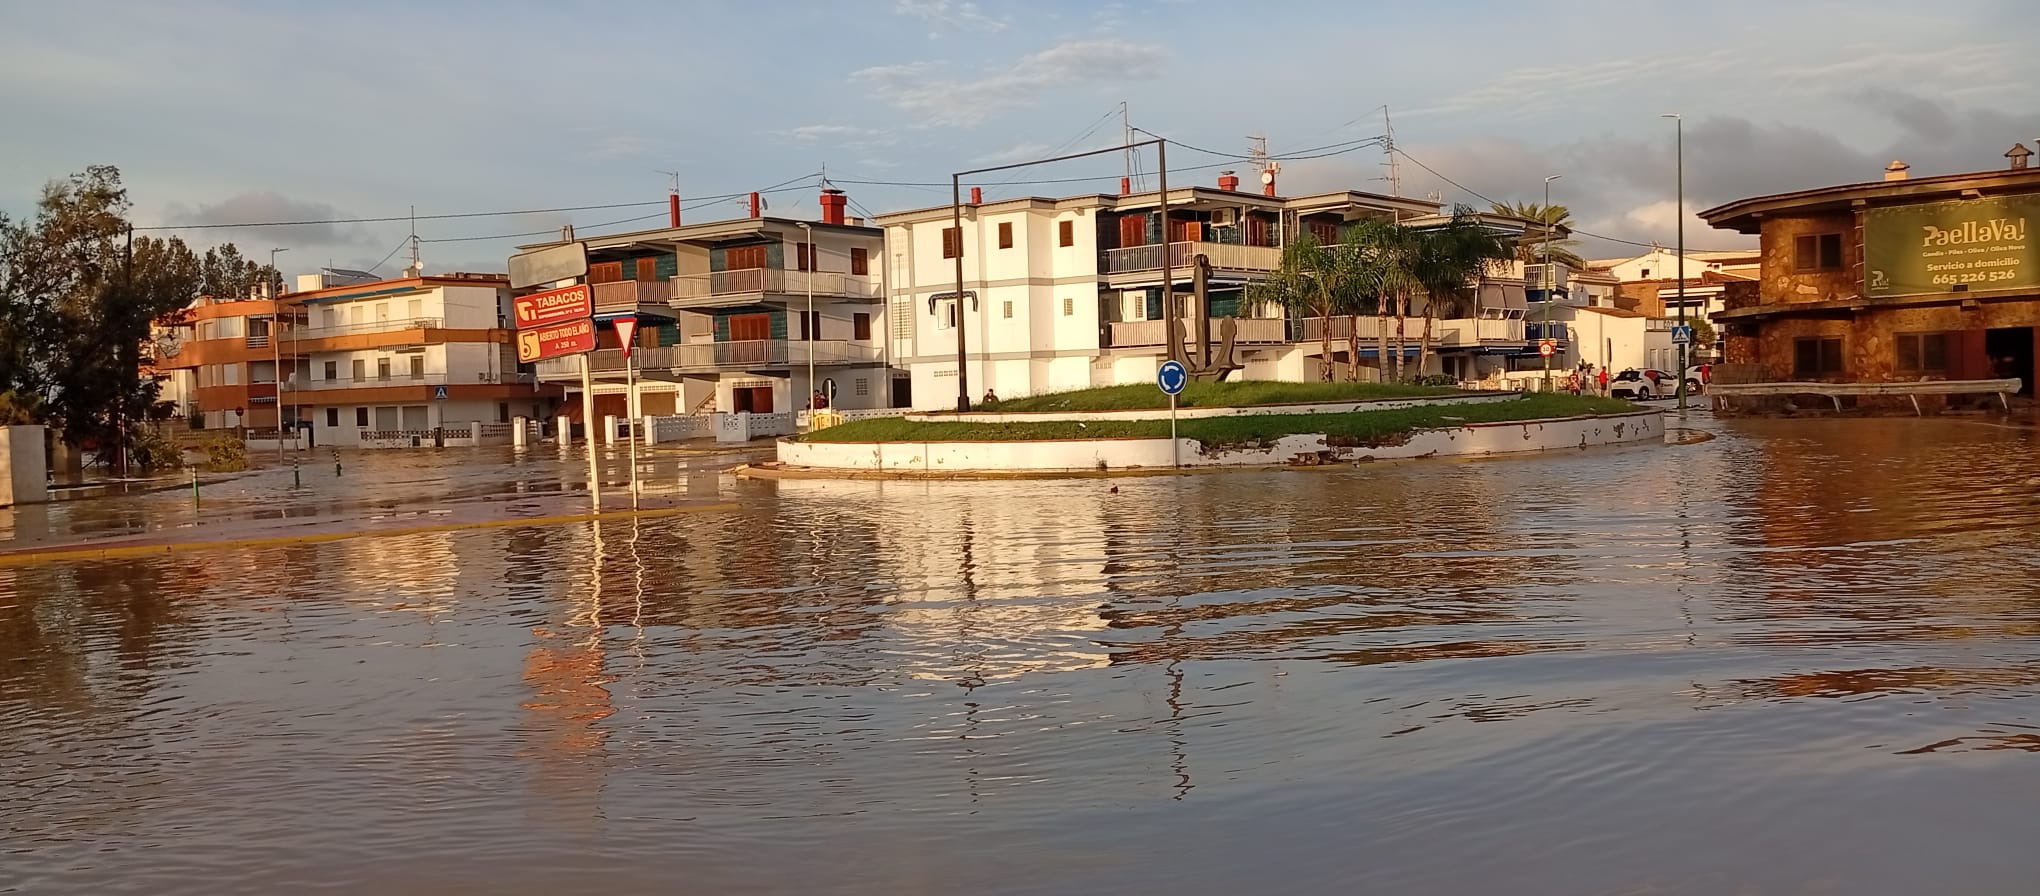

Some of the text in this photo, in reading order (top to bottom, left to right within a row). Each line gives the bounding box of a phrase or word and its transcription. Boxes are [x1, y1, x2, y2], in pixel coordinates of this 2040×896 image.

[1922, 217, 2025, 247] PaellaVa!
[1927, 261, 1965, 271] Servicio
[1974, 257, 2020, 268] domicilio
[1932, 269, 2015, 284] 665 226 526
[535, 290, 585, 309] TABACOS
[540, 323, 590, 342] ABIERTO TODO EL AÑO
